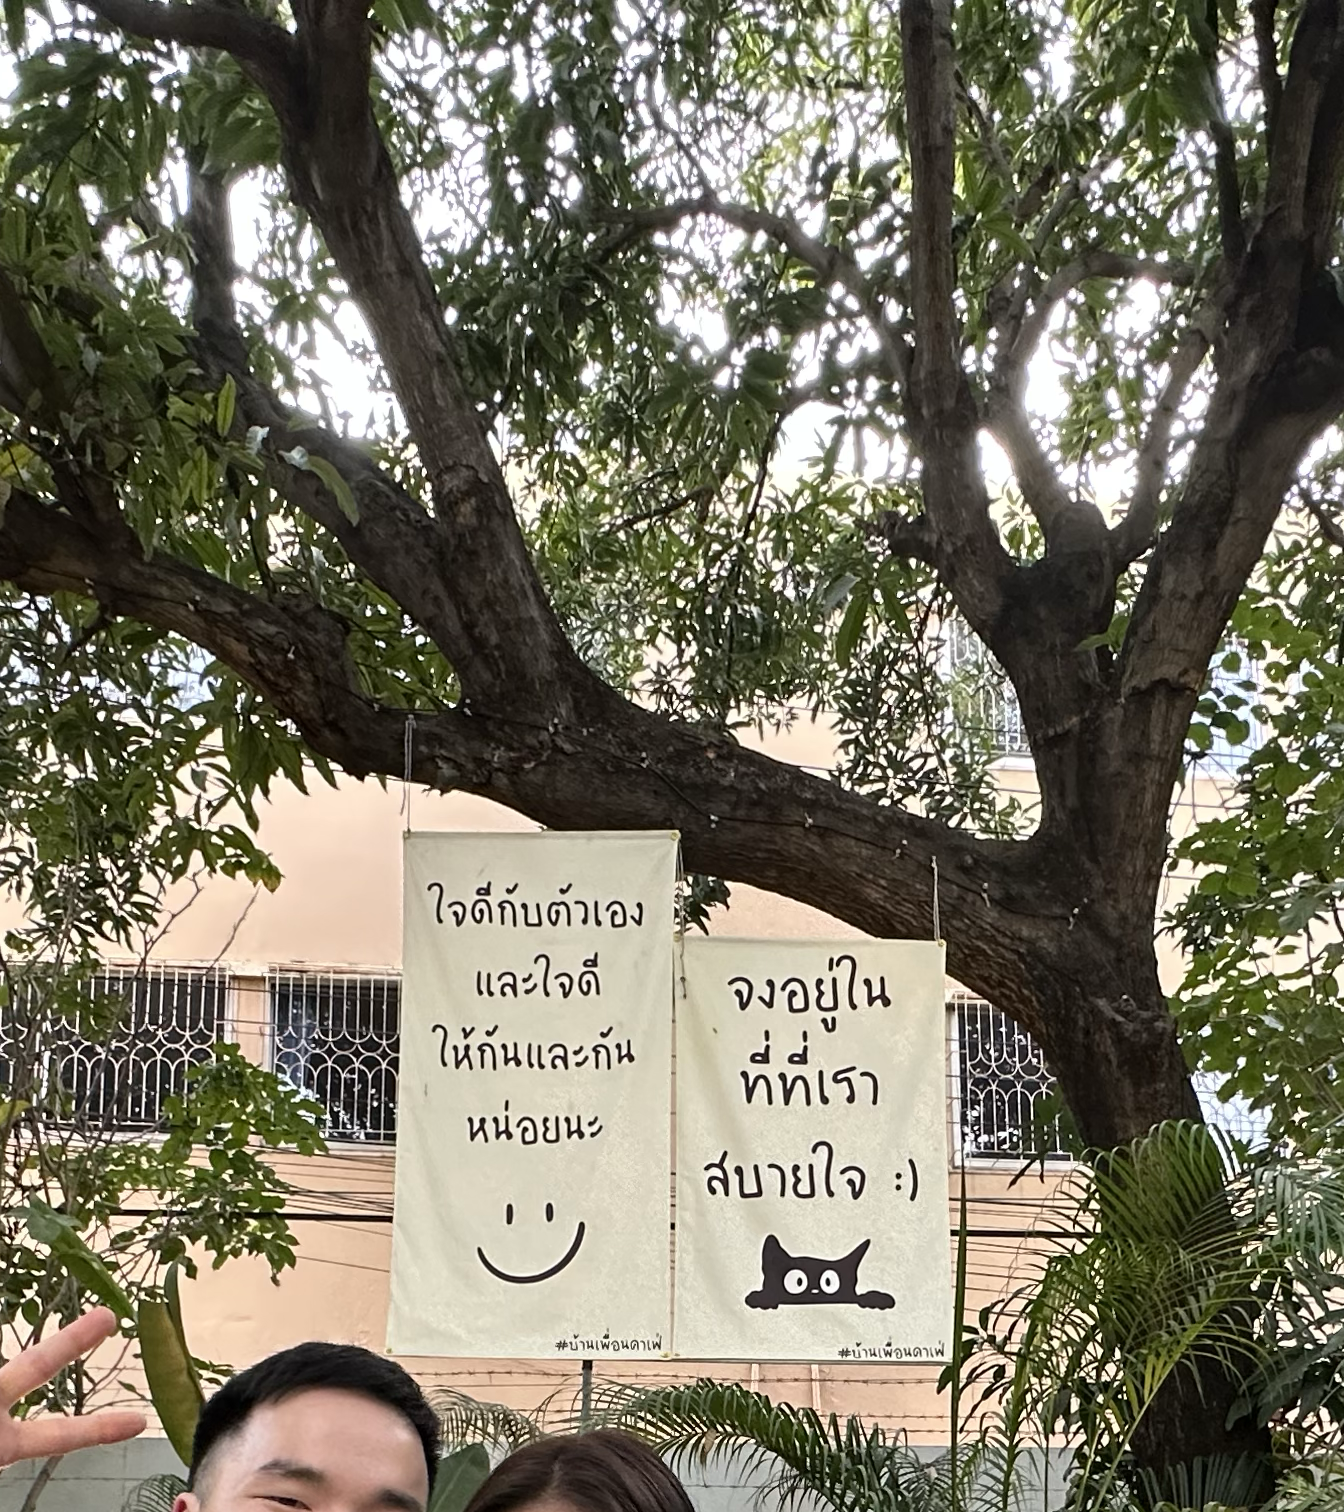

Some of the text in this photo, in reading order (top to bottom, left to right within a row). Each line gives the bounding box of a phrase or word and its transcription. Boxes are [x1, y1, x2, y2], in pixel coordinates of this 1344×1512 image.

[426, 880, 644, 929] ใจดีกับตัวเอง
[475, 951, 601, 999] และใจดี
[727, 954, 892, 1033] จงอยู่ใน
[431, 1023, 636, 1072] ให้กันและกัน
[739, 1030, 879, 1107] ที่ที่เรา
[466, 1099, 604, 1146] หน่อยนะ
[703, 1140, 866, 1201] สบายใจ
[554, 1327, 662, 1352] #บ้านเพื่อนคาเฟ่
[837, 1335, 945, 1360] #บ้านเพื่อนคาเฟ่
